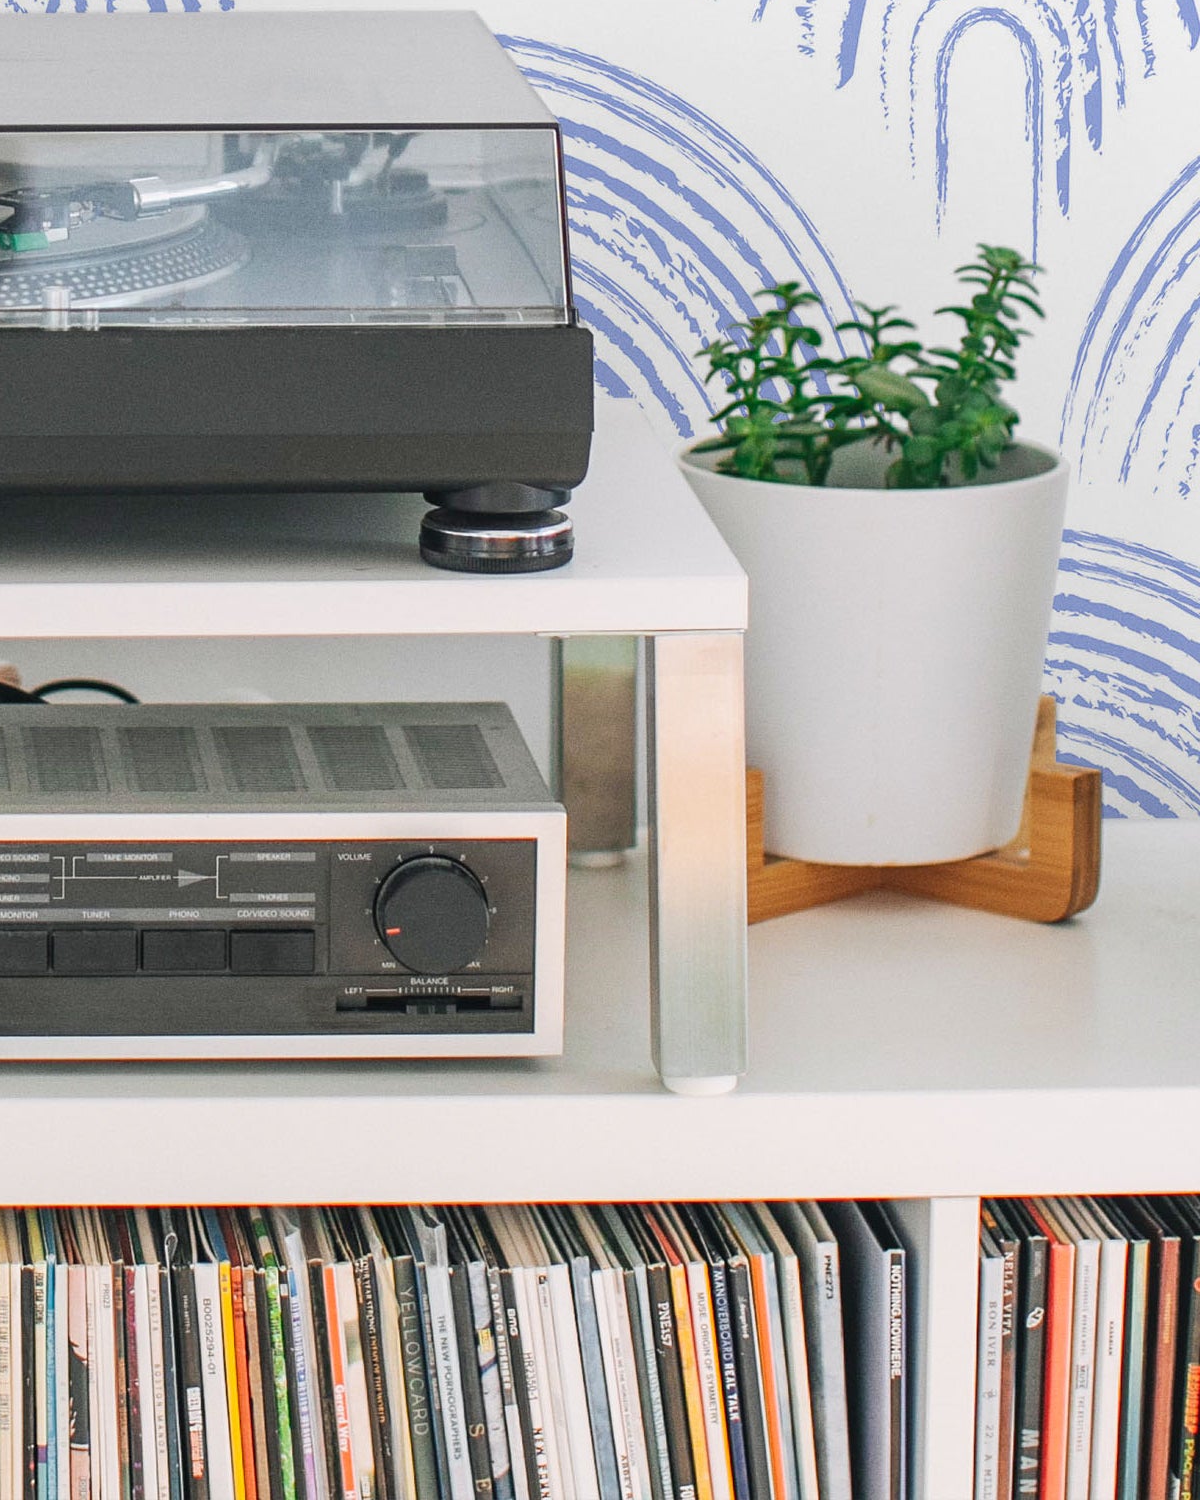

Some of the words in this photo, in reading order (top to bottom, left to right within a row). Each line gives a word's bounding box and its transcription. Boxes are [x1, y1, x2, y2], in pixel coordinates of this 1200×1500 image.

[824, 1255, 834, 1300] PNE273
[1003, 1251, 1015, 1297] NELLA
[363, 1281, 373, 1300] YEAR
[491, 1293, 501, 1316] DAY
[365, 1301, 377, 1334] STRONG
[436, 1315, 448, 1333] THE
[495, 1318, 504, 1332] TO
[507, 1308, 518, 1338] BMG
[658, 1301, 673, 1348] PNE157
[987, 1301, 998, 1330] BON
[1002, 1304, 1012, 1337] VITA
[203, 1298, 216, 1375] B0025294-01
[439, 1337, 451, 1362] NEW
[700, 1323, 712, 1356] ORIGIN
[987, 1336, 998, 1367] IVER
[400, 1286, 429, 1436] YELLOWCARD
[498, 1335, 512, 1390] REMEMBER
[704, 1359, 714, 1372] OF
[724, 1363, 737, 1390] REAL
[334, 1384, 351, 1425] Gerard
[443, 1365, 462, 1460] PORNOGRAPHERS
[705, 1374, 719, 1425] SYMMETRY
[728, 1394, 740, 1420] TALK
[337, 1427, 350, 1452] Way
[984, 1454, 994, 1462] A
